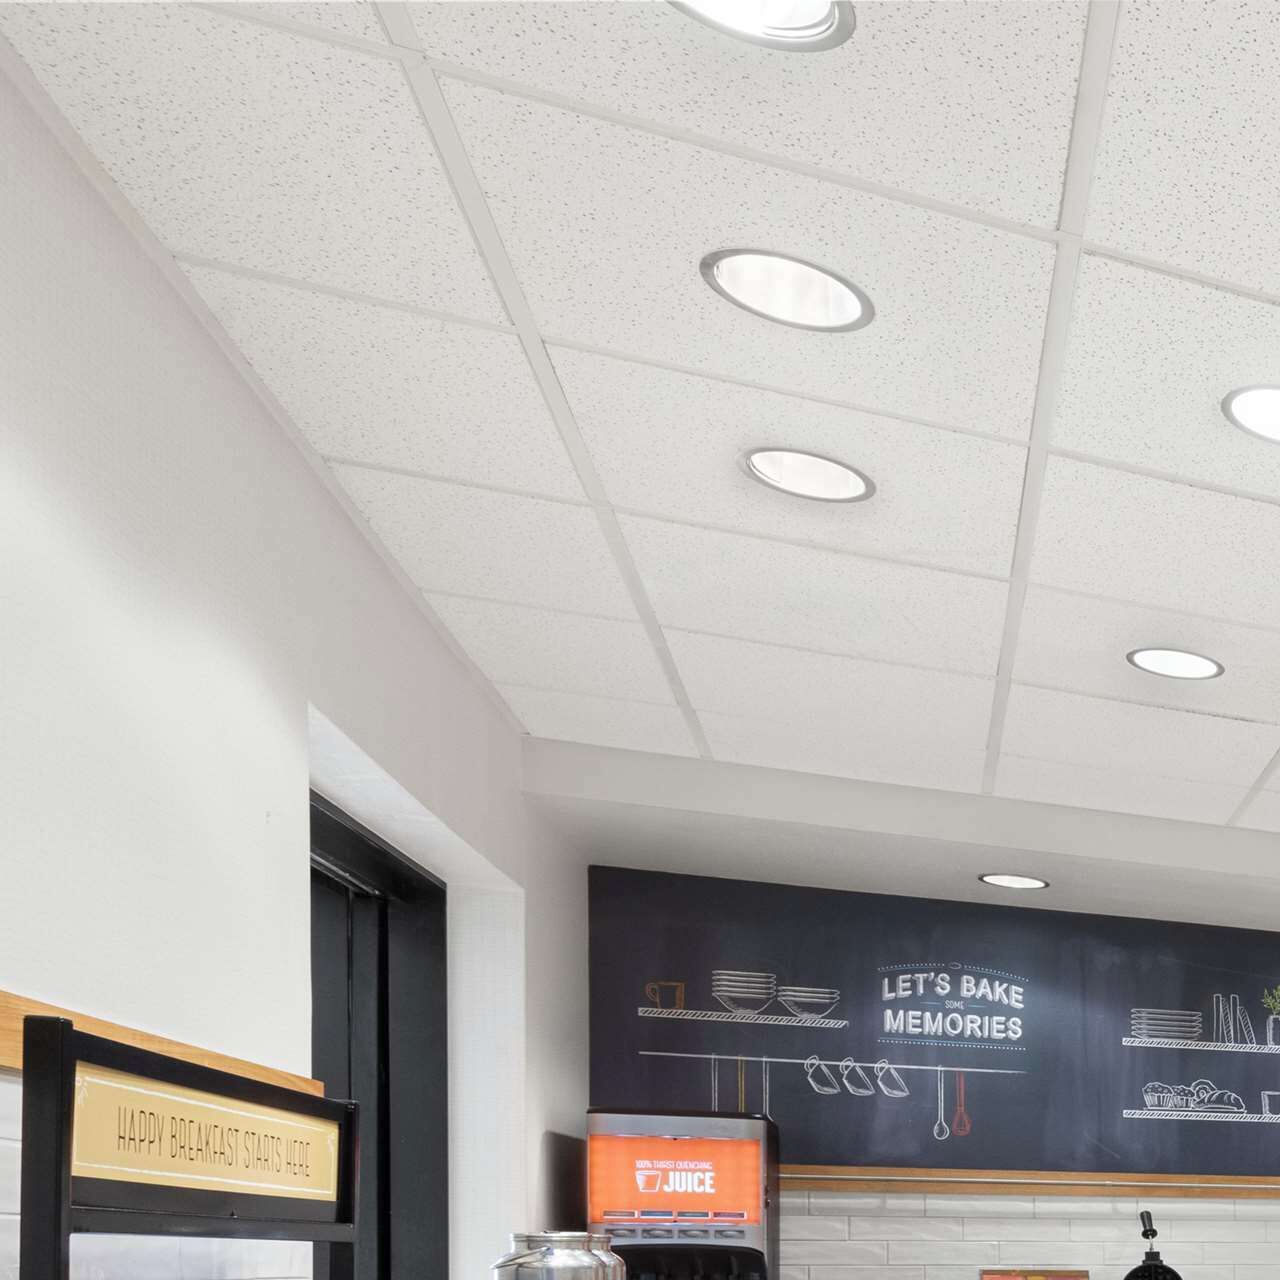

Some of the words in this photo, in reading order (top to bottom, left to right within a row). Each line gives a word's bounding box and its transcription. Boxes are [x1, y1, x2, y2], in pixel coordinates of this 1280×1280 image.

[882, 972, 950, 1001] LET'S
[960, 975, 1025, 1009] BAKE
[944, 1000, 965, 1010] SOME
[884, 1009, 1023, 1040] MEMORIES
[117, 1105, 165, 1158] HAPPY
[170, 1115, 239, 1169] BREAKFAST
[244, 1131, 281, 1173] STARTS
[286, 1138, 311, 1178] HERE
[663, 1171, 716, 1194] JUICE
